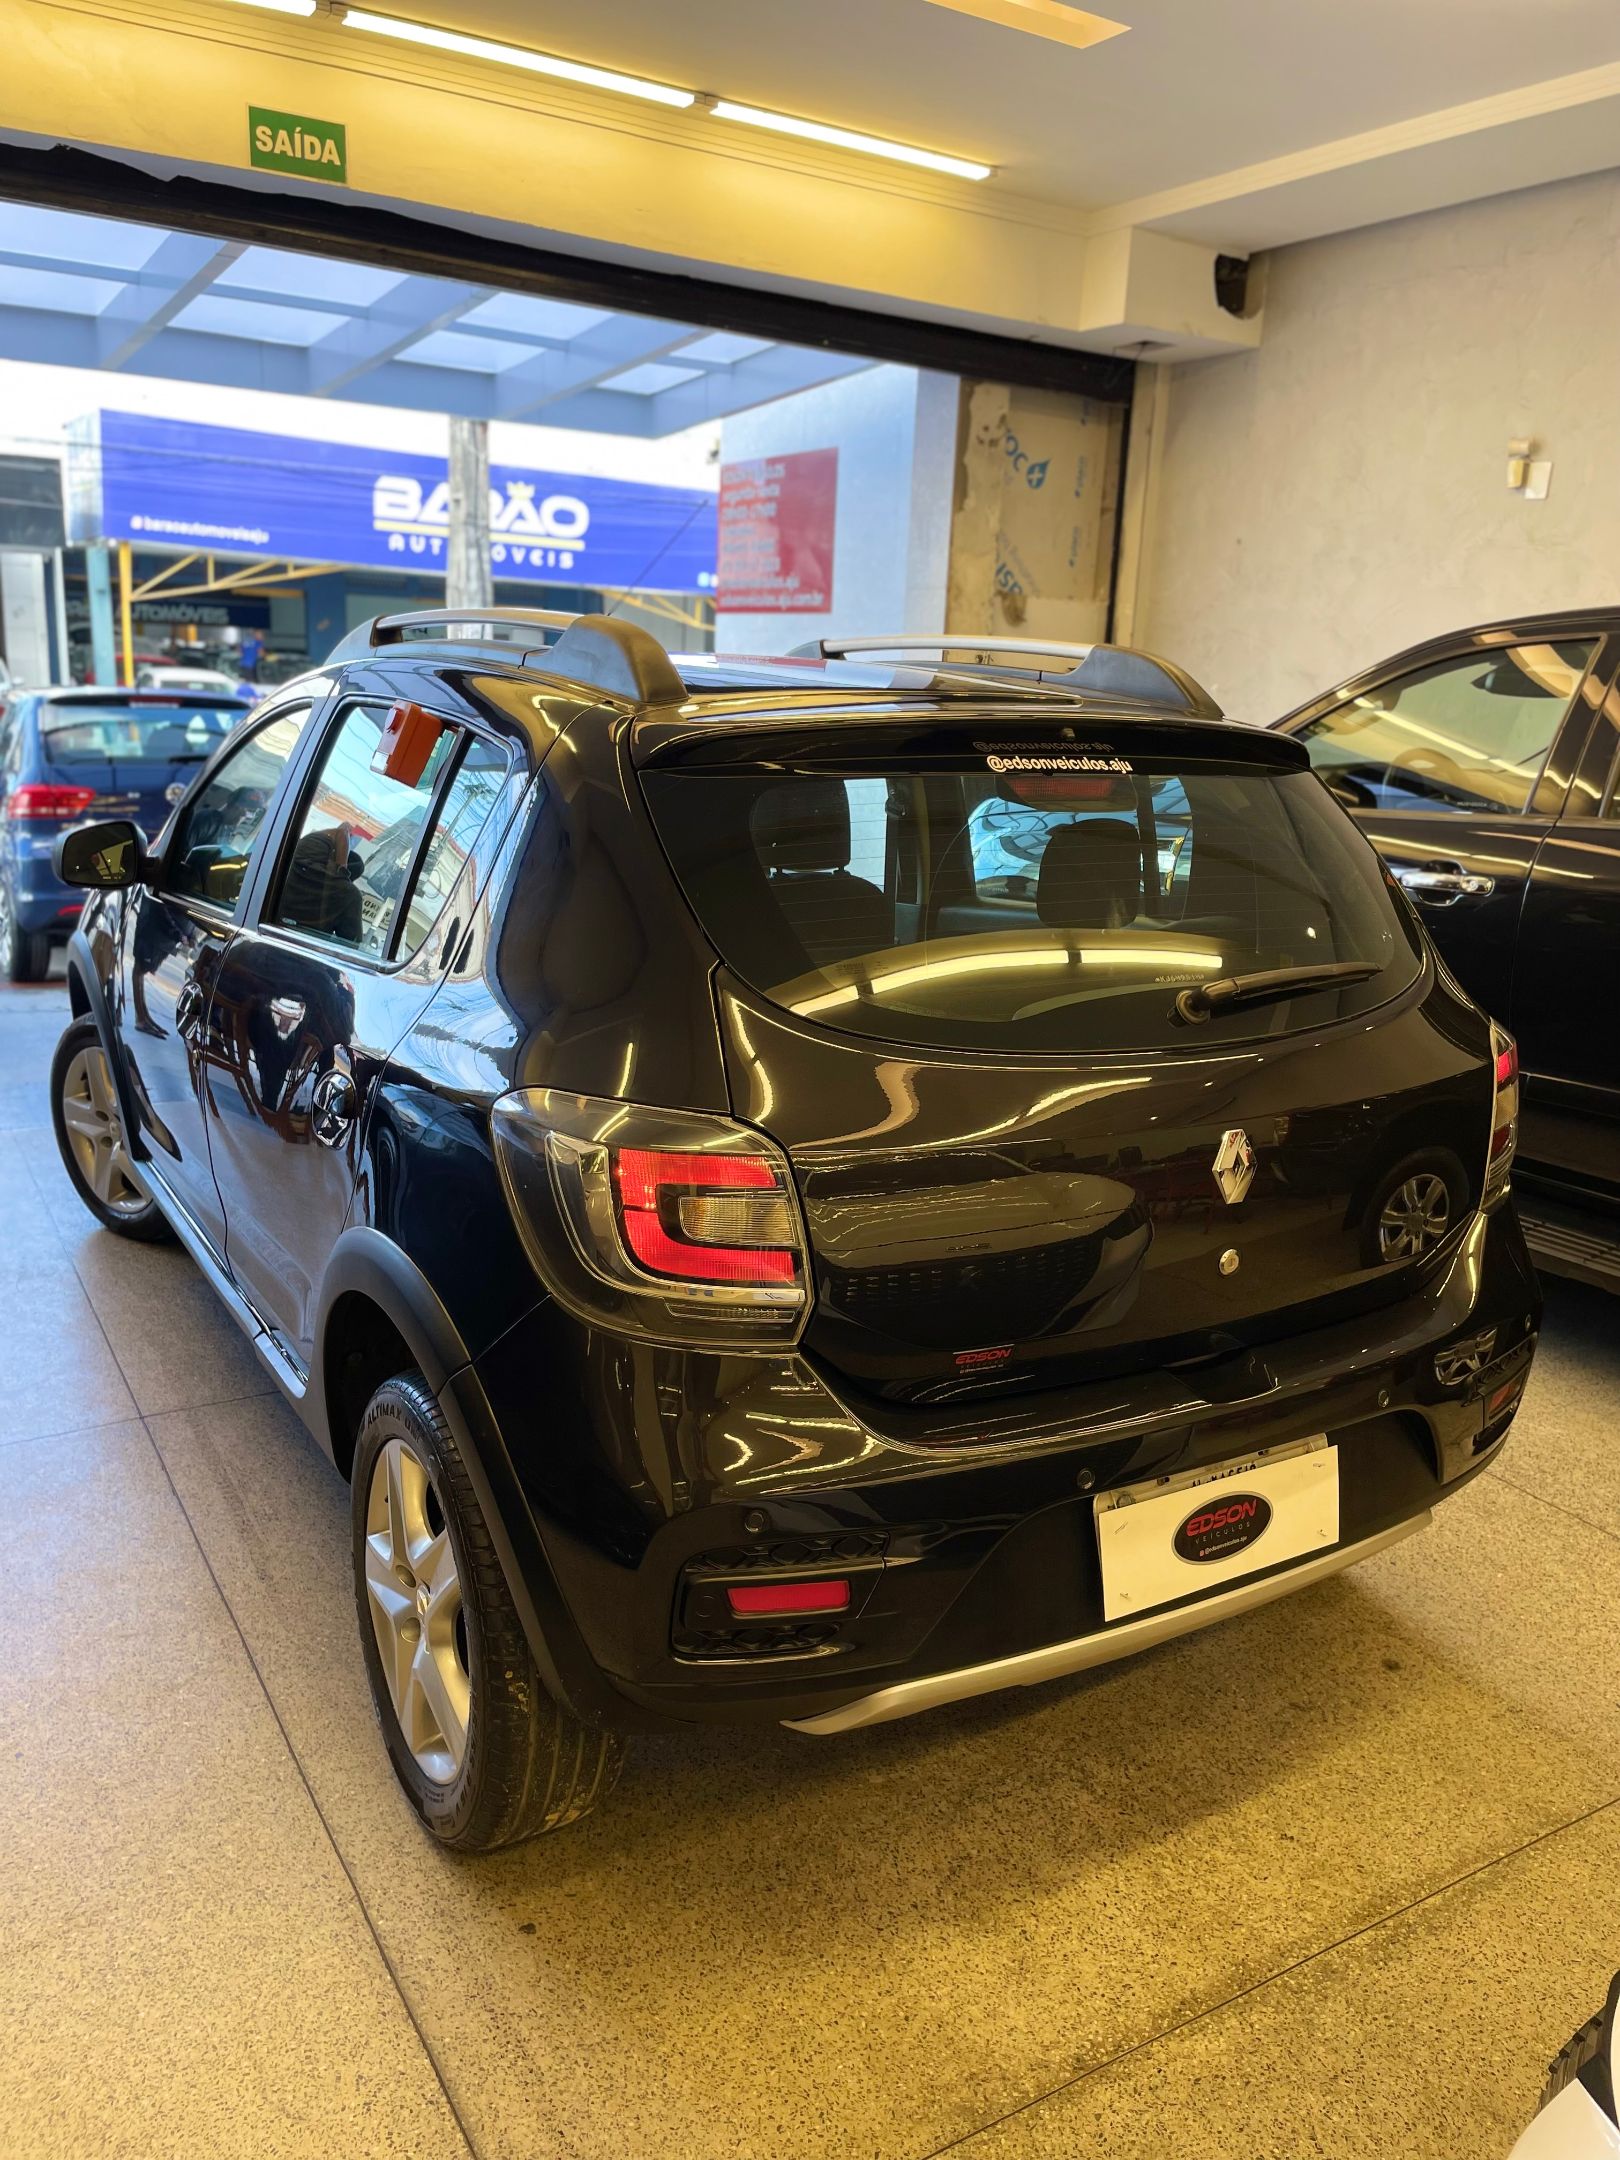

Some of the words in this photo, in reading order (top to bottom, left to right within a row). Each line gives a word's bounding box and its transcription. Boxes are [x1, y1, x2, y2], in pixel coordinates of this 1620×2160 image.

[255, 125, 341, 166] SAÍDA
[986, 754, 1134, 774] @edsonveiculos.aju
[955, 1348, 1012, 1365] EDSON
[1185, 1499, 1258, 1537] EDSON
